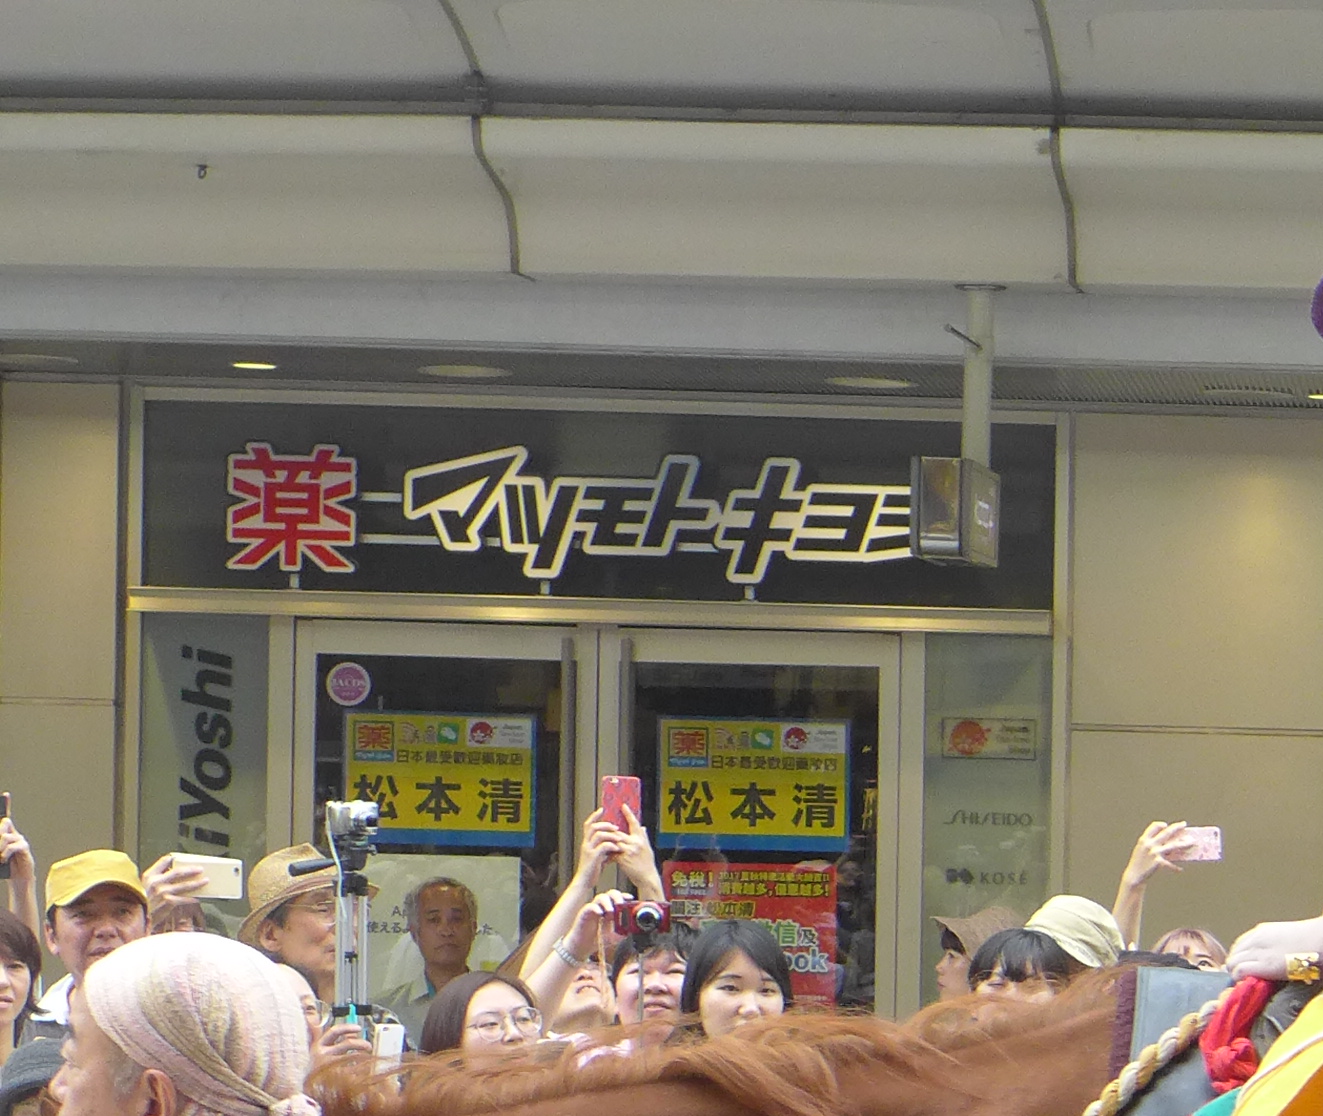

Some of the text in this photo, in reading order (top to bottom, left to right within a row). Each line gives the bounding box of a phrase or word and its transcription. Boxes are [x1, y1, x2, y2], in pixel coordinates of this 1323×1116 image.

[227, 442, 358, 573] 薬
[179, 644, 233, 857] iYoshi
[353, 773, 523, 824] 松本清
[668, 780, 838, 828] 松本清
[943, 809, 1033, 826] SHISEIDO
